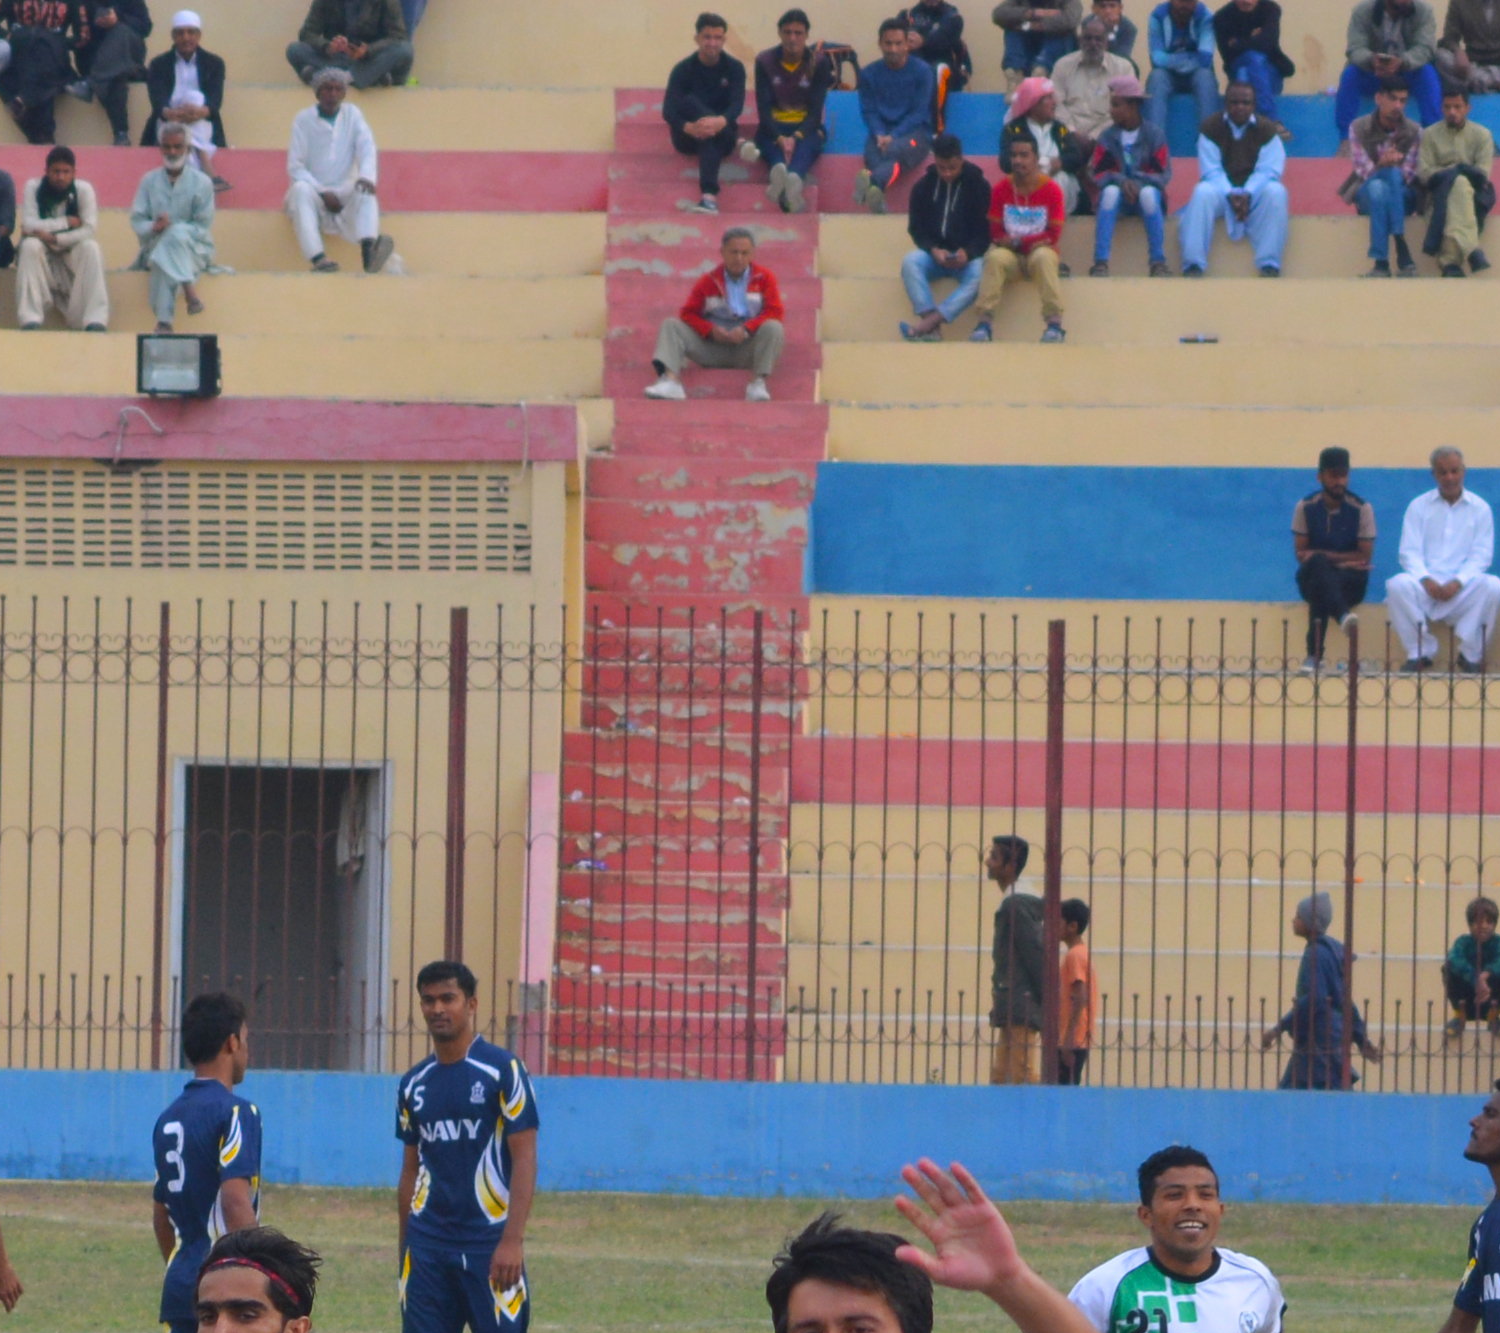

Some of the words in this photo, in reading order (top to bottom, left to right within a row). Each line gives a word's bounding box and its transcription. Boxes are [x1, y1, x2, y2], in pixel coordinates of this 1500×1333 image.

[413, 1085, 426, 1112] 5
[419, 1119, 481, 1142] NAVY
[163, 1121, 186, 1193] 3
